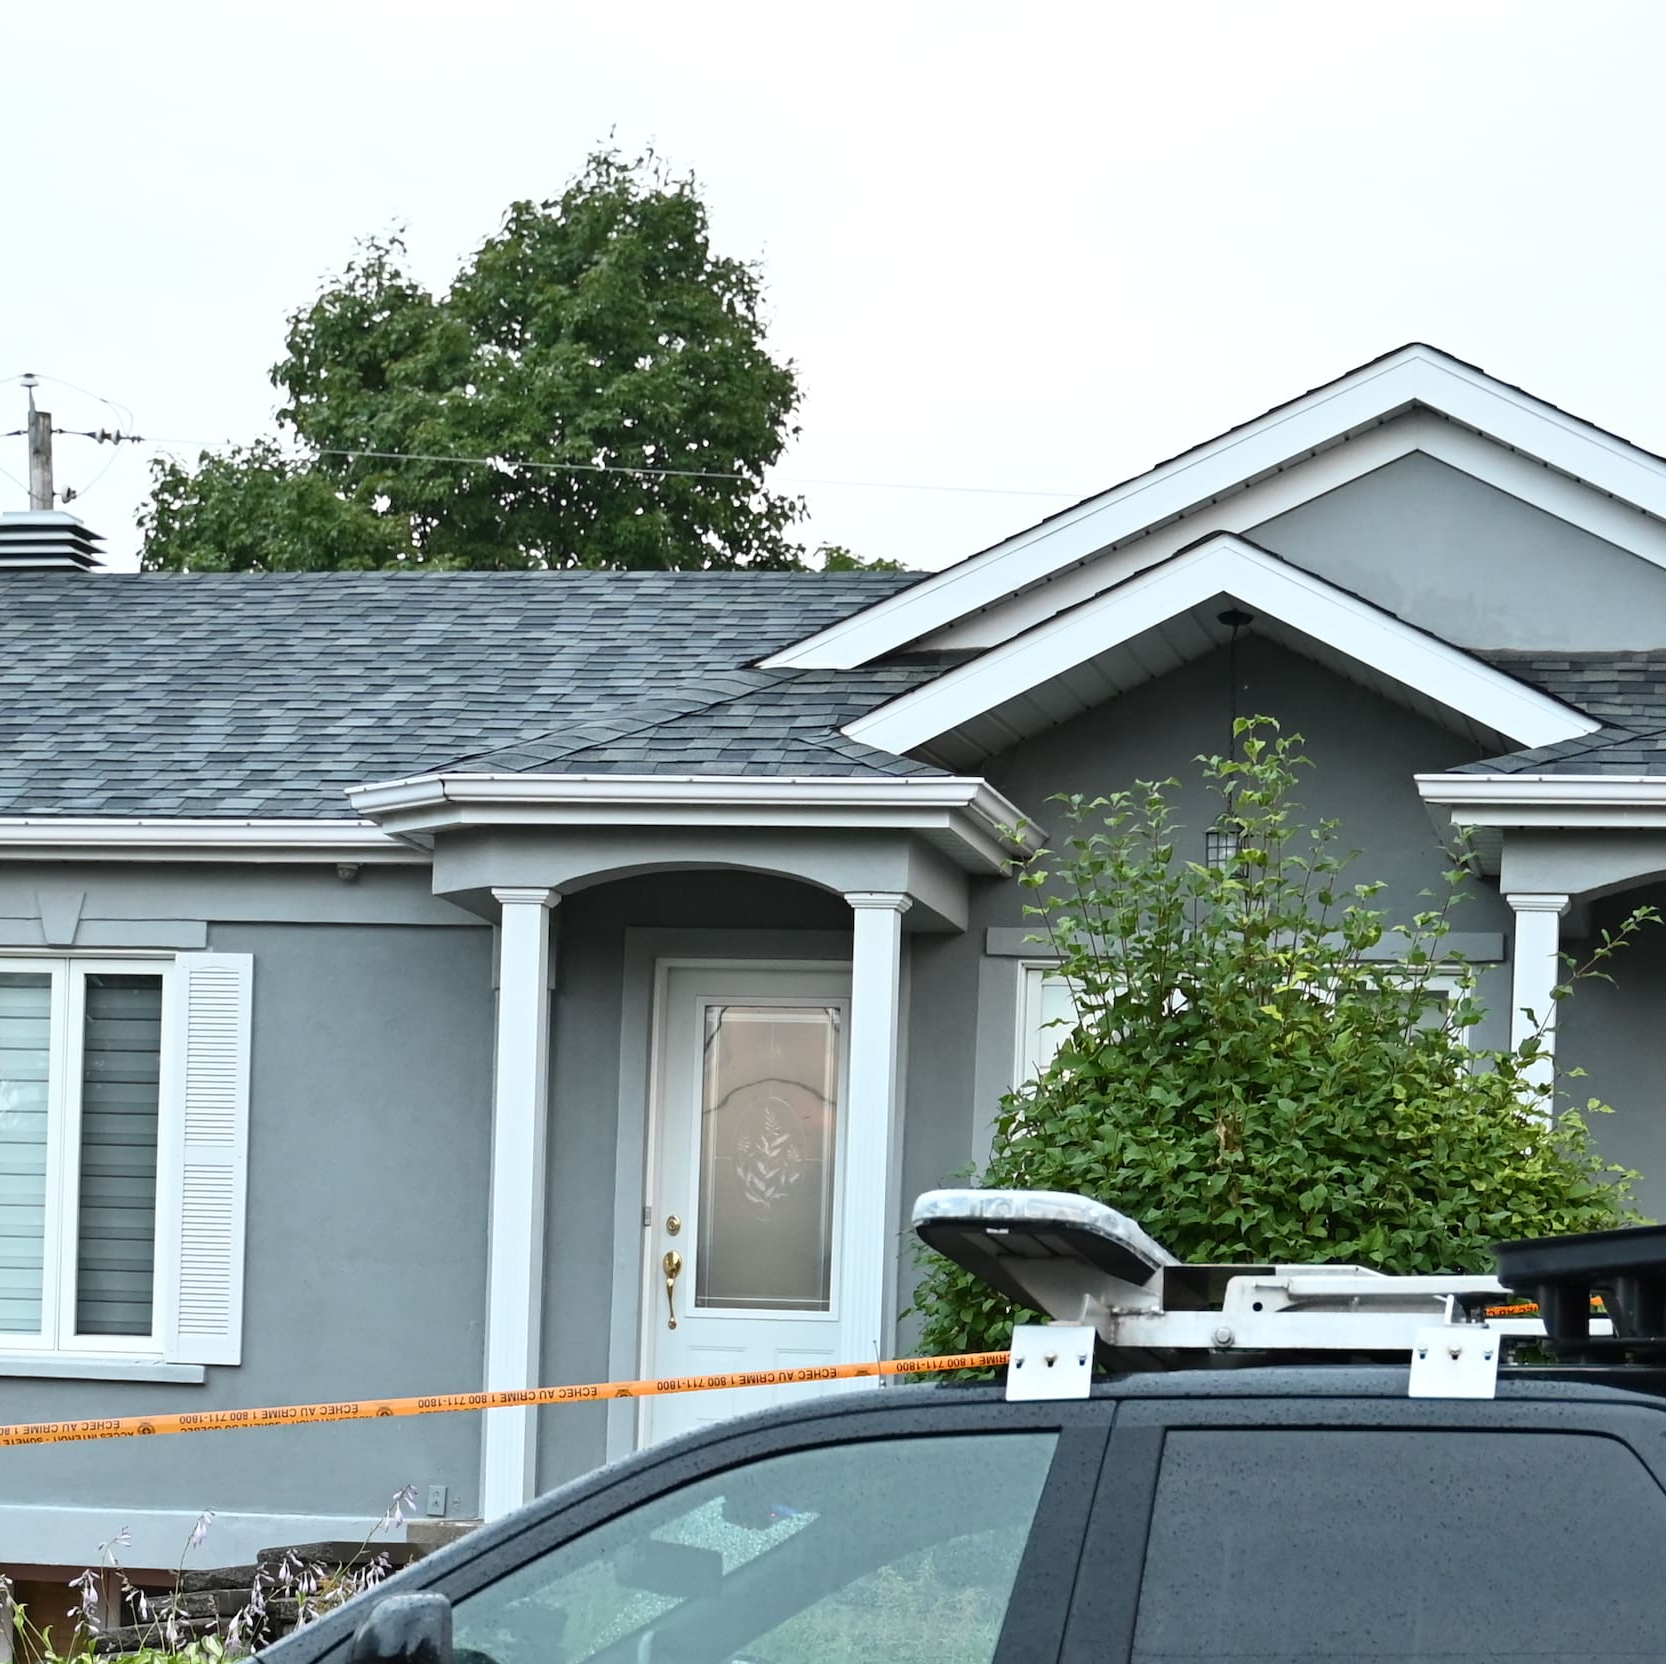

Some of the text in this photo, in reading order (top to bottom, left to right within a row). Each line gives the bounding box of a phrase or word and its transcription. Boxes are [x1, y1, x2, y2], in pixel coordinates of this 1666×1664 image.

[947, 1359, 966, 1368] 800
[979, 1354, 1011, 1364] RIME
[896, 1361, 944, 1371] 711-1800
[739, 1374, 774, 1385] CRIME
[779, 1371, 794, 1381] AU
[657, 1380, 704, 1391] 711-1800
[707, 1377, 726, 1387] 800
[500, 1391, 535, 1402] CRIME
[539, 1389, 555, 1399] AU
[418, 1397, 466, 1408] 711-1800
[468, 1395, 487, 1404] 800
[261, 1409, 297, 1420] CRIME
[300, 1407, 316, 1416] AU
[179, 1415, 226, 1425] 711-1800
[230, 1413, 248, 1422] 800
[23, 1425, 58, 1435] CRIME
[61, 1423, 77, 1432] AU
